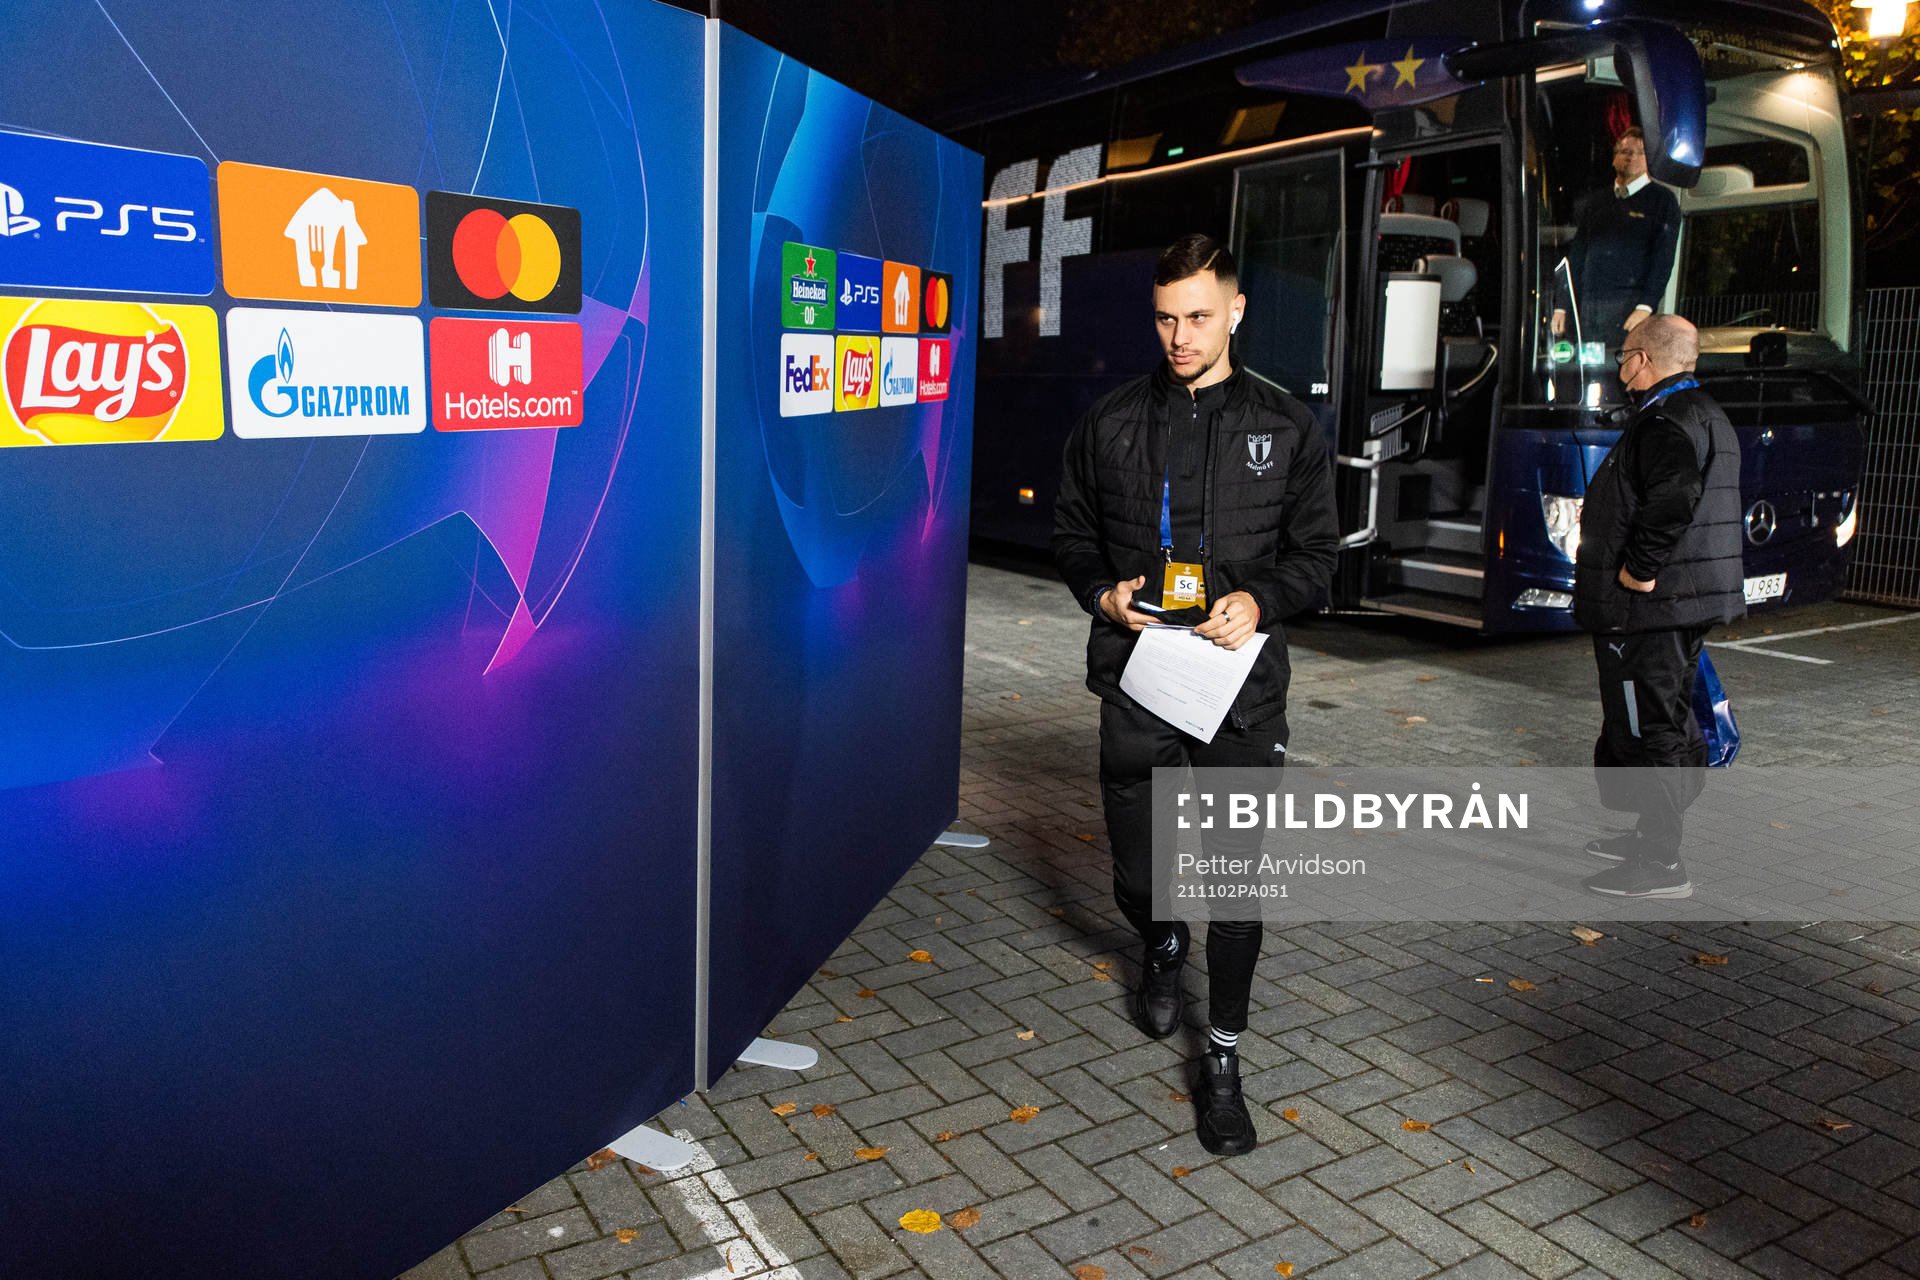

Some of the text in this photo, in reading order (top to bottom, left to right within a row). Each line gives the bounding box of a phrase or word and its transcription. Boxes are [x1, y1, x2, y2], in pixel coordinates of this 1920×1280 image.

[54, 196, 197, 243] PS5
[792, 280, 827, 301] Heineken
[854, 284, 879, 305] PS5
[20, 327, 177, 422] Lay's
[785, 354, 830, 394] FedEx
[843, 350, 873, 399] Lay's
[892, 376, 914, 396] GAZPROM
[919, 379, 948, 396] Hotels.com
[301, 385, 410, 418] GAZPROM
[445, 391, 572, 420] Hotels.com
[1179, 579, 1193, 590] Sc
[1758, 577, 1780, 595] 983
